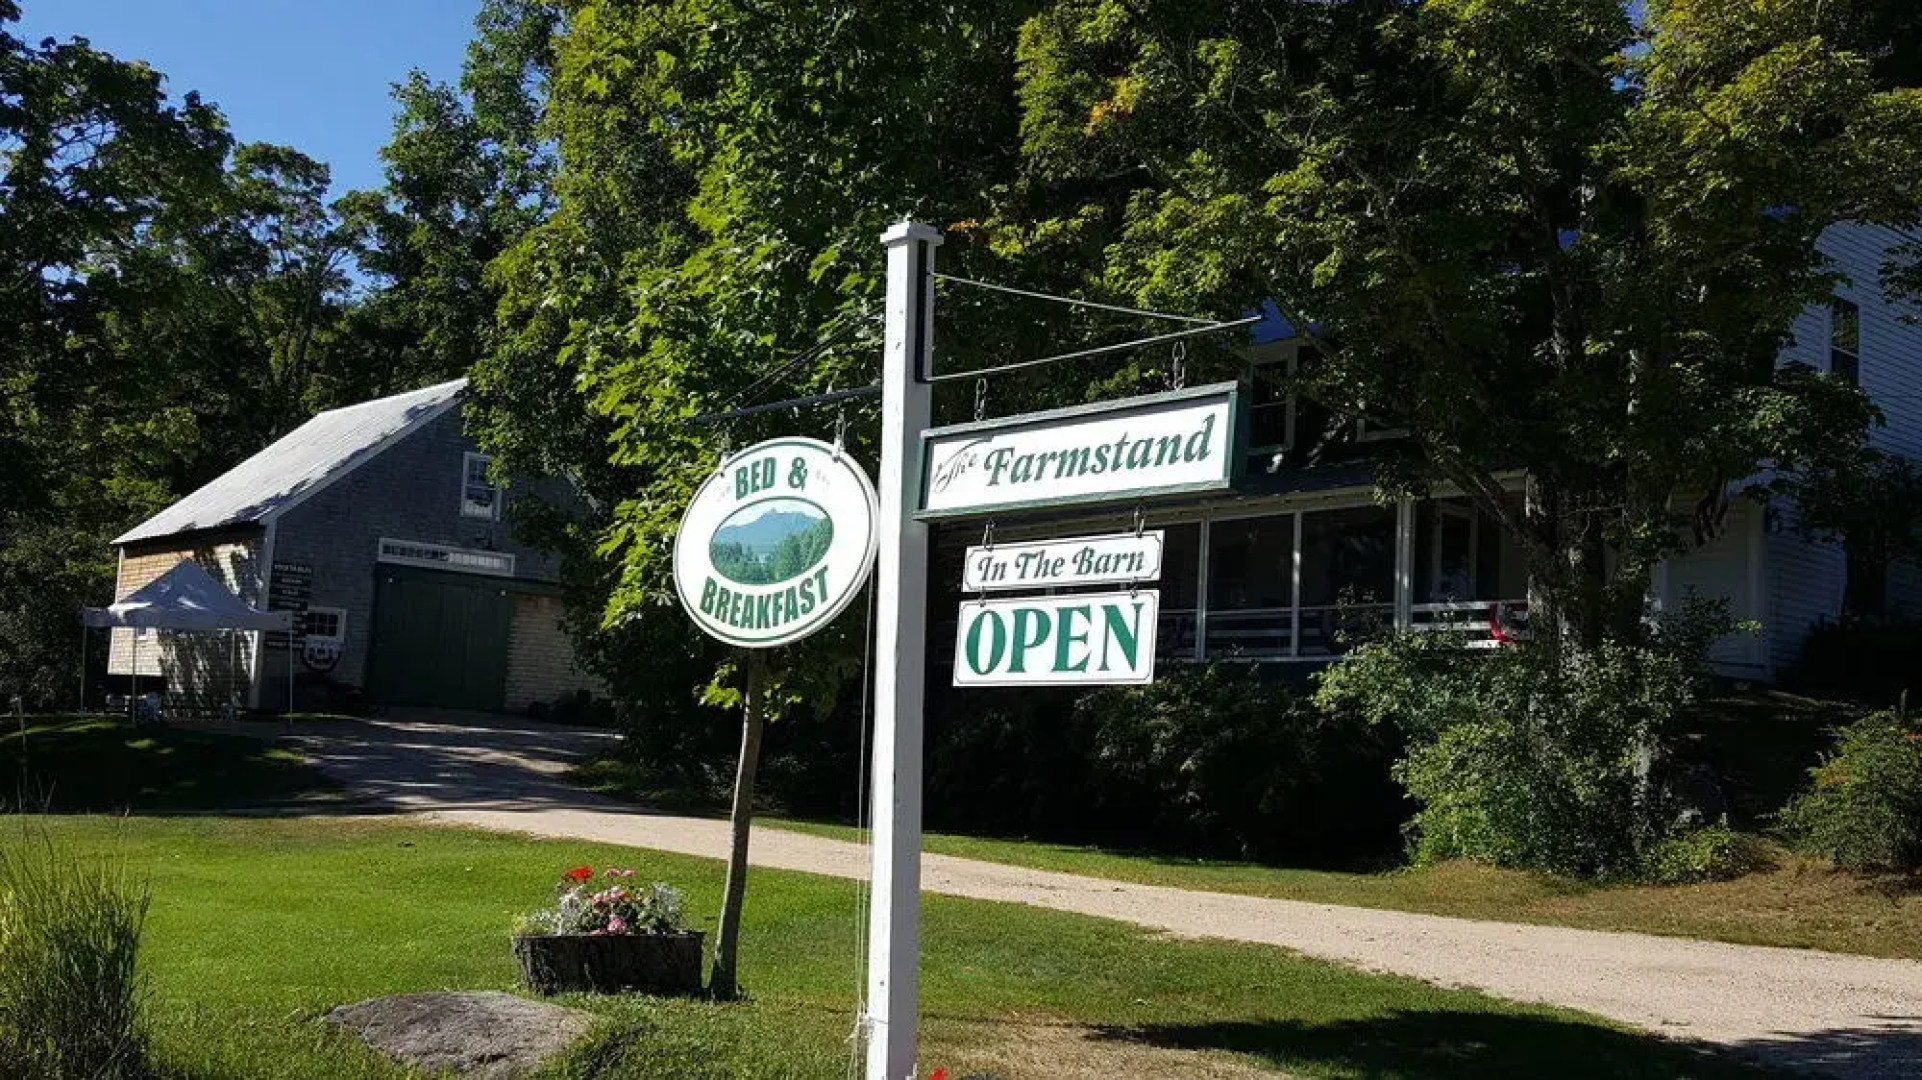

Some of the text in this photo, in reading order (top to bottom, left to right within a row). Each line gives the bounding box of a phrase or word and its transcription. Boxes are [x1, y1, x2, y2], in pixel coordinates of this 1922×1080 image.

[735, 457, 777, 500] BED
[788, 456, 808, 491] &
[984, 413, 1216, 486] Farmstand
[977, 546, 1145, 582] In The Barn
[699, 565, 829, 630] BREAKFAST
[965, 602, 1145, 675] OPEN
